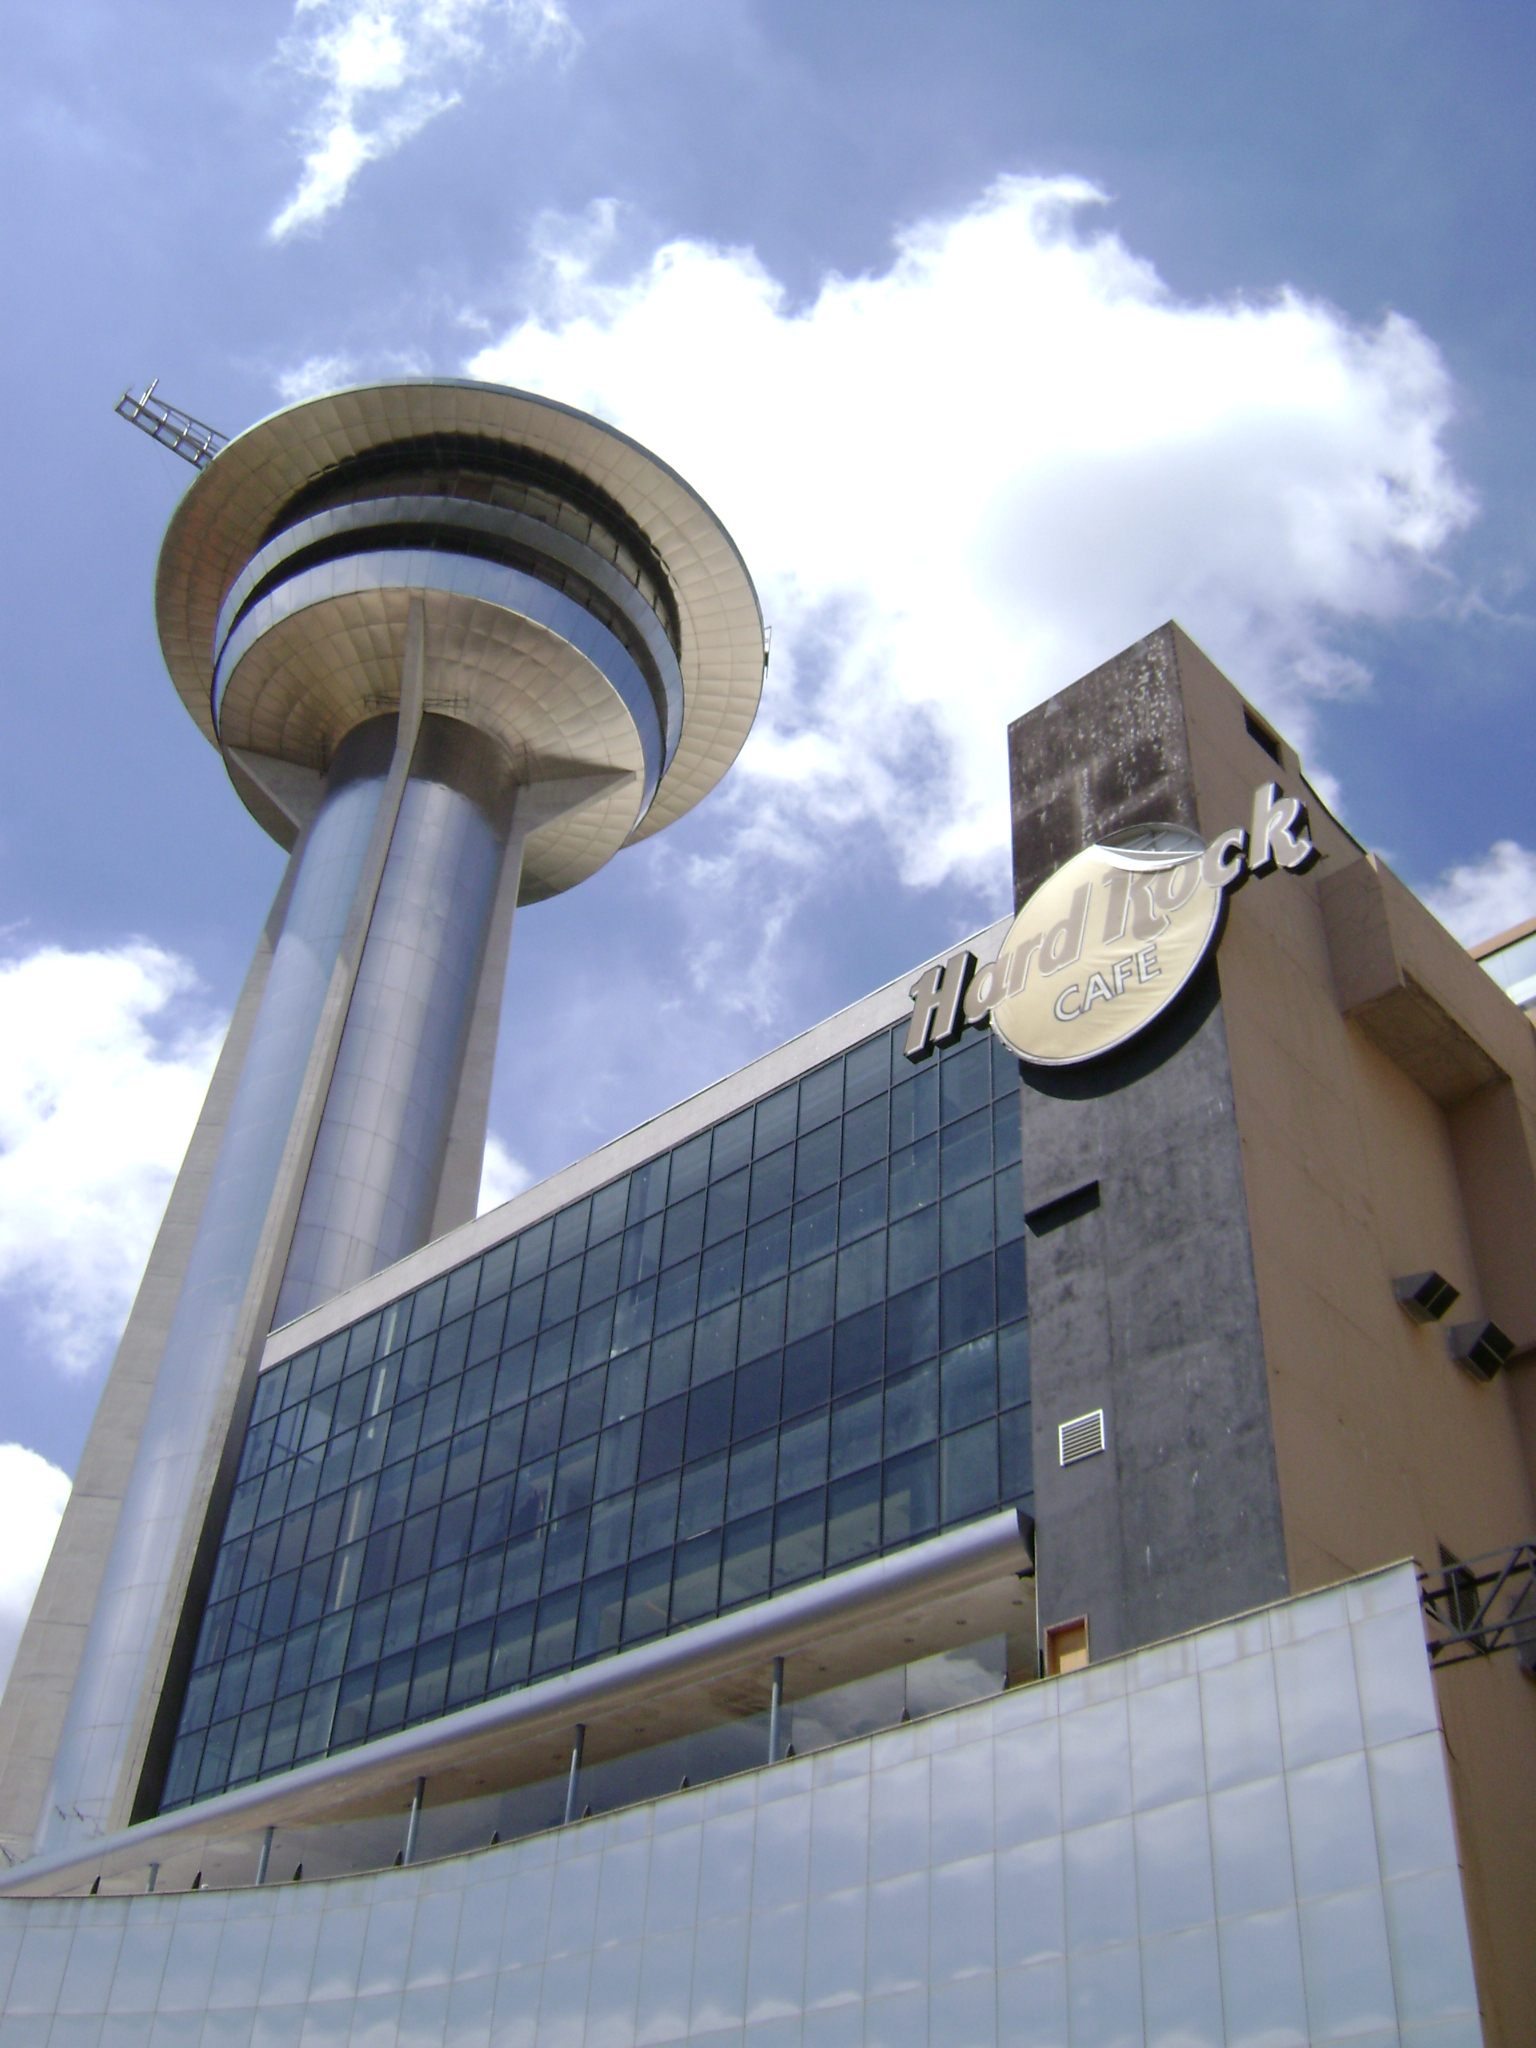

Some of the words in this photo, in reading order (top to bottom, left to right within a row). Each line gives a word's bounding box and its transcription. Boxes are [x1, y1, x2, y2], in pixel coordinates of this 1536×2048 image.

[904, 882, 1093, 1062] Hard
[1101, 782, 1316, 945] Rock
[1054, 944, 1162, 1022] CAFE
